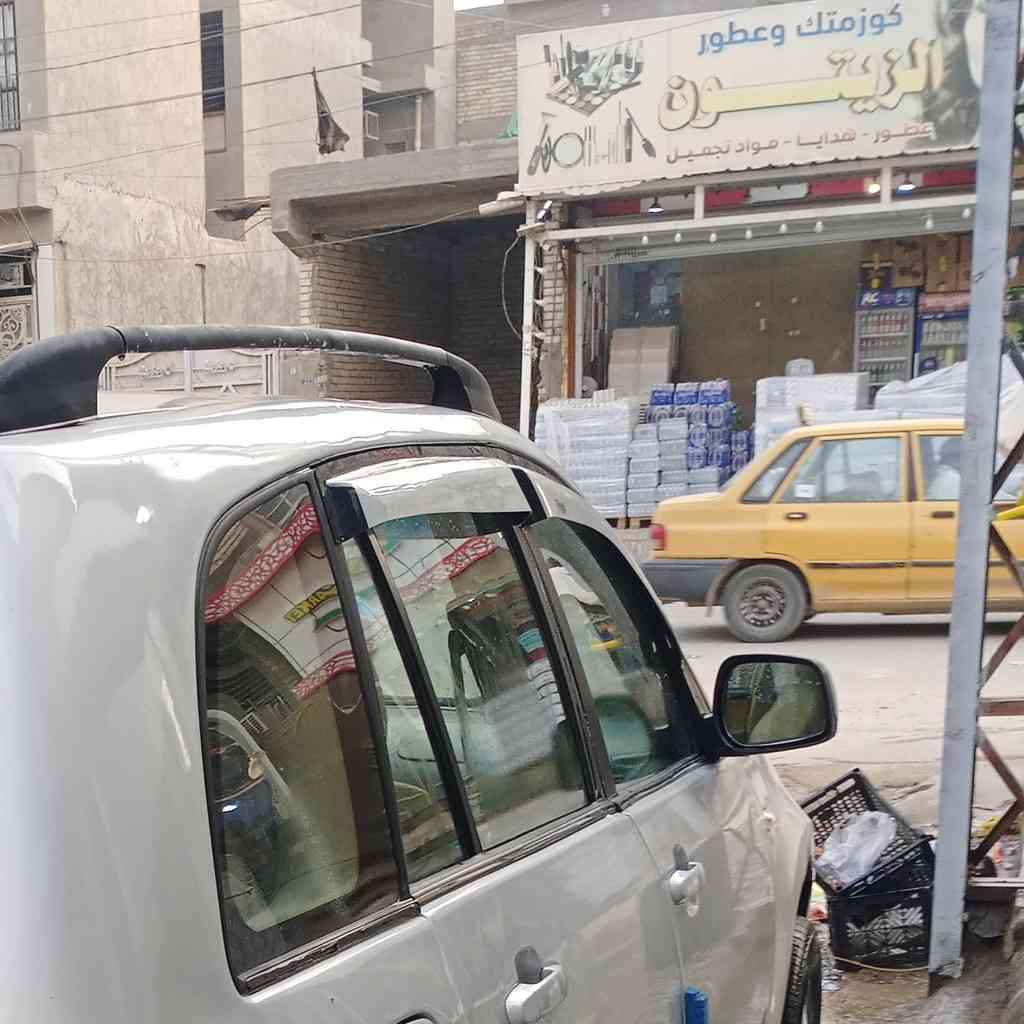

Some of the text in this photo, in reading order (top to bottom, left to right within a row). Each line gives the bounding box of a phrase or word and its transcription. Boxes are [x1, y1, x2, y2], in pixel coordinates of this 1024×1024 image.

[697, 3, 903, 55] كوزمتك وعطور
[667, 140, 729, 164] تجميل
[735, 137, 778, 155] مواد
